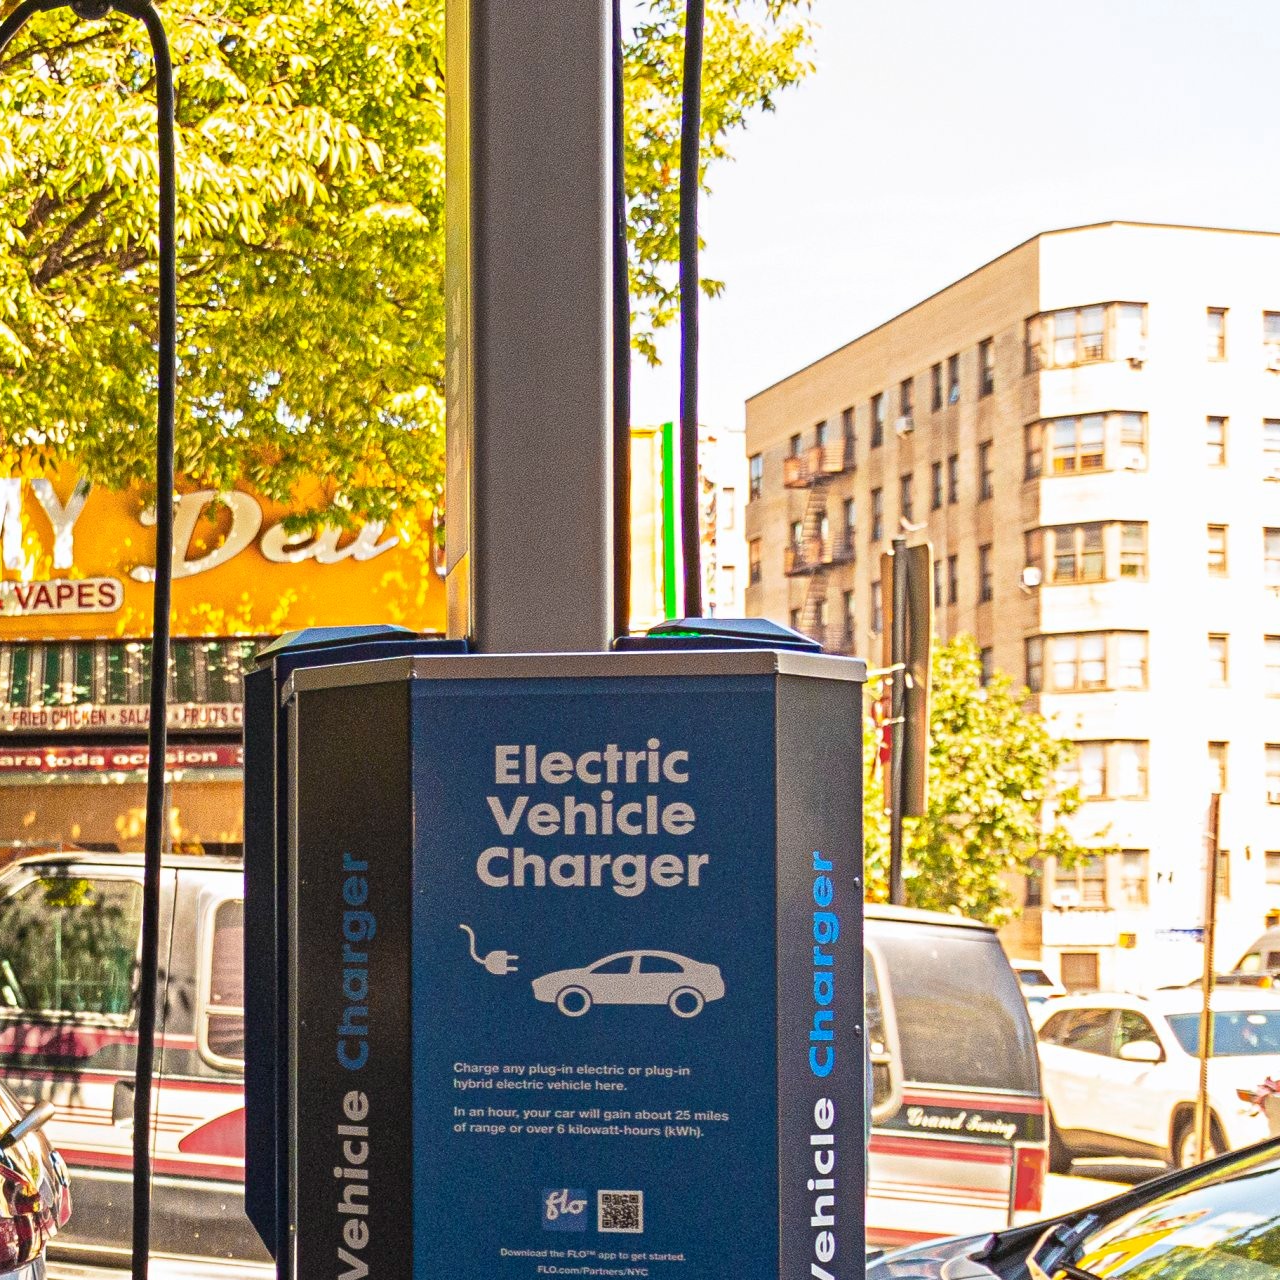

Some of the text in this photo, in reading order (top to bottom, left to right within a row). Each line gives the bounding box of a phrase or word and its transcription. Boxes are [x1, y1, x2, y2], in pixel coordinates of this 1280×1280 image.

[15, 583, 116, 609] VAPES
[12, 710, 47, 726] FRIED
[52, 709, 106, 727] CHICKEN
[120, 708, 150, 724] SALA
[183, 707, 228, 723] FRUITS
[45, 752, 105, 767] toda
[112, 751, 218, 765] ocsion
[495, 737, 689, 784] Electric
[486, 790, 696, 835] Vehicle
[476, 846, 709, 897] Charger
[336, 852, 376, 1071] Charger
[808, 851, 840, 1079] Charger
[454, 1063, 690, 1077] Charge any plug-in electric or plug-in
[454, 1079, 627, 1090] hybrid electric vehicle here.
[454, 1107, 729, 1121] In an hour, your car will gain about 25 miles
[454, 1123, 704, 1138] of range or over 6 kilowatt-hours (kWh).
[545, 1189, 587, 1221] flo
[500, 1248, 547, 1258] Download
[550, 1249, 564, 1258] the
[598, 1251, 616, 1260] app
[631, 1252, 647, 1261] get
[649, 1253, 686, 1261] started.
[537, 1265, 649, 1276] FLO.com/Partners/NYC
